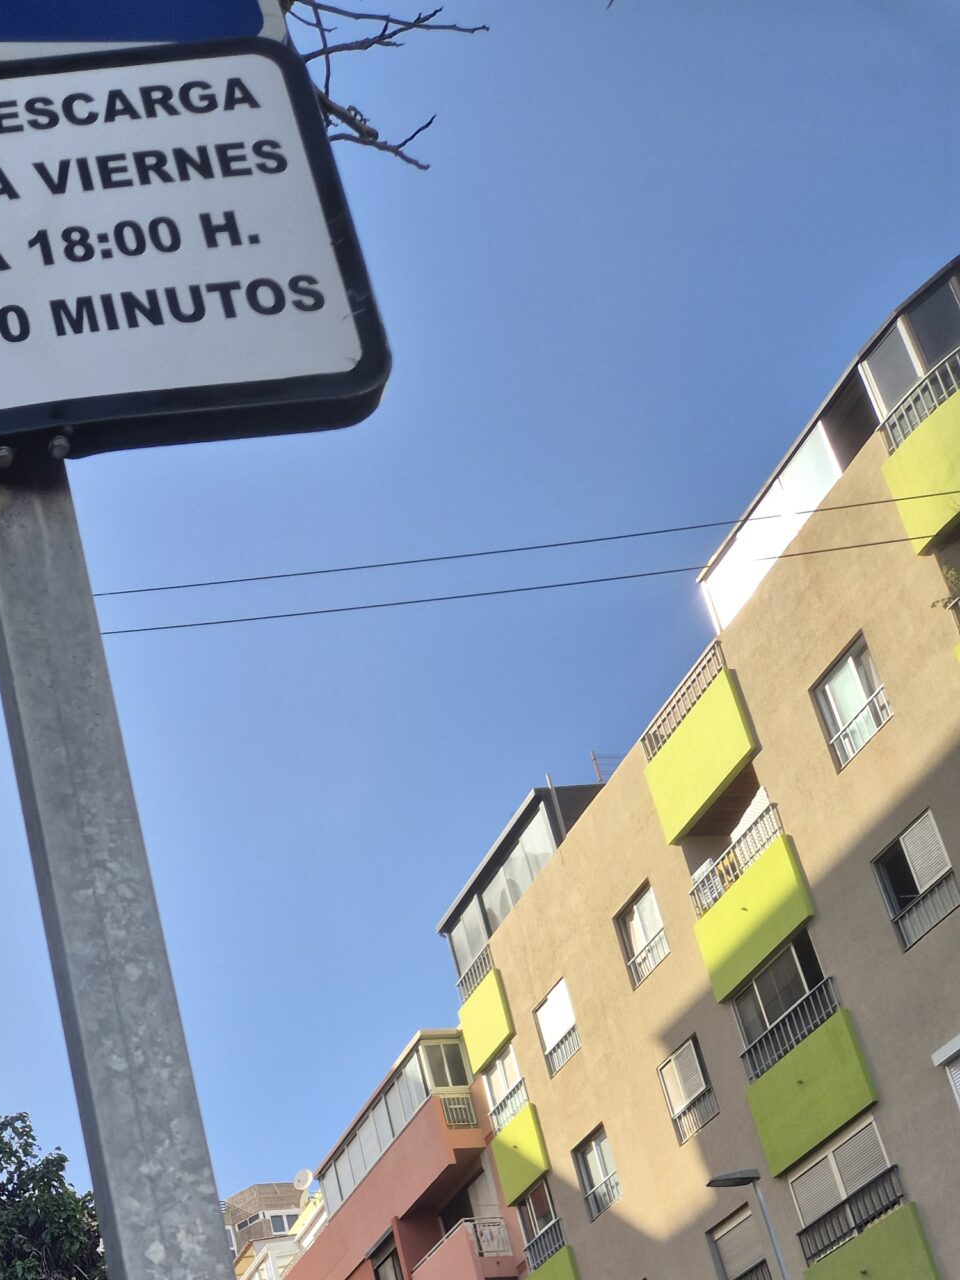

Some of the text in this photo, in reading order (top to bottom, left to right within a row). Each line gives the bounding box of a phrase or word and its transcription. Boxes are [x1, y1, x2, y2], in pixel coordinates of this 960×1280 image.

[33, 139, 289, 195] VIERNES
[27, 216, 182, 267] 18:00
[199, 210, 261, 249] H.
[49, 274, 326, 337] MINUTOS
